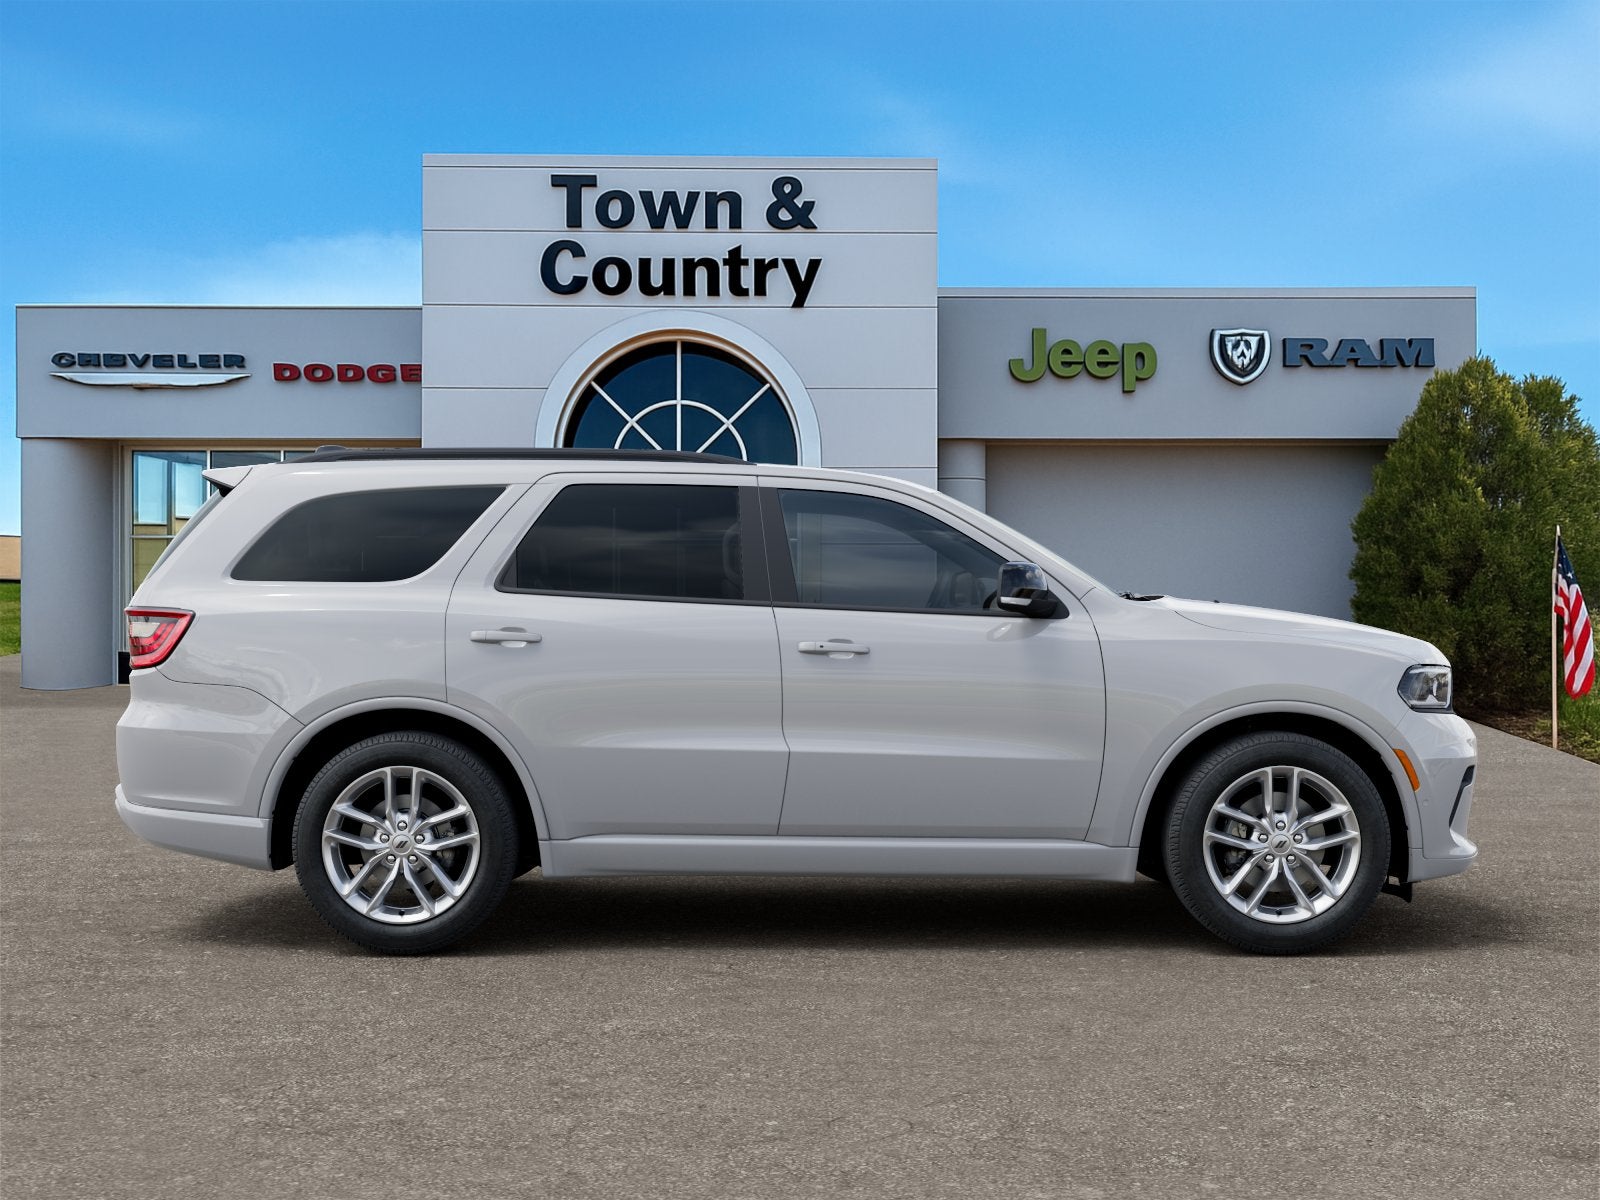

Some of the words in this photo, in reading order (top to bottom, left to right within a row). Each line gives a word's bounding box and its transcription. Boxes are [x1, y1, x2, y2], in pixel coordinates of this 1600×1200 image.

[550, 174, 742, 229] Town
[766, 176, 818, 229] &
[540, 239, 823, 308] Country
[272, 362, 422, 383] DODGE
[1008, 327, 1158, 393] Jeep
[1282, 337, 1436, 368] RAM
